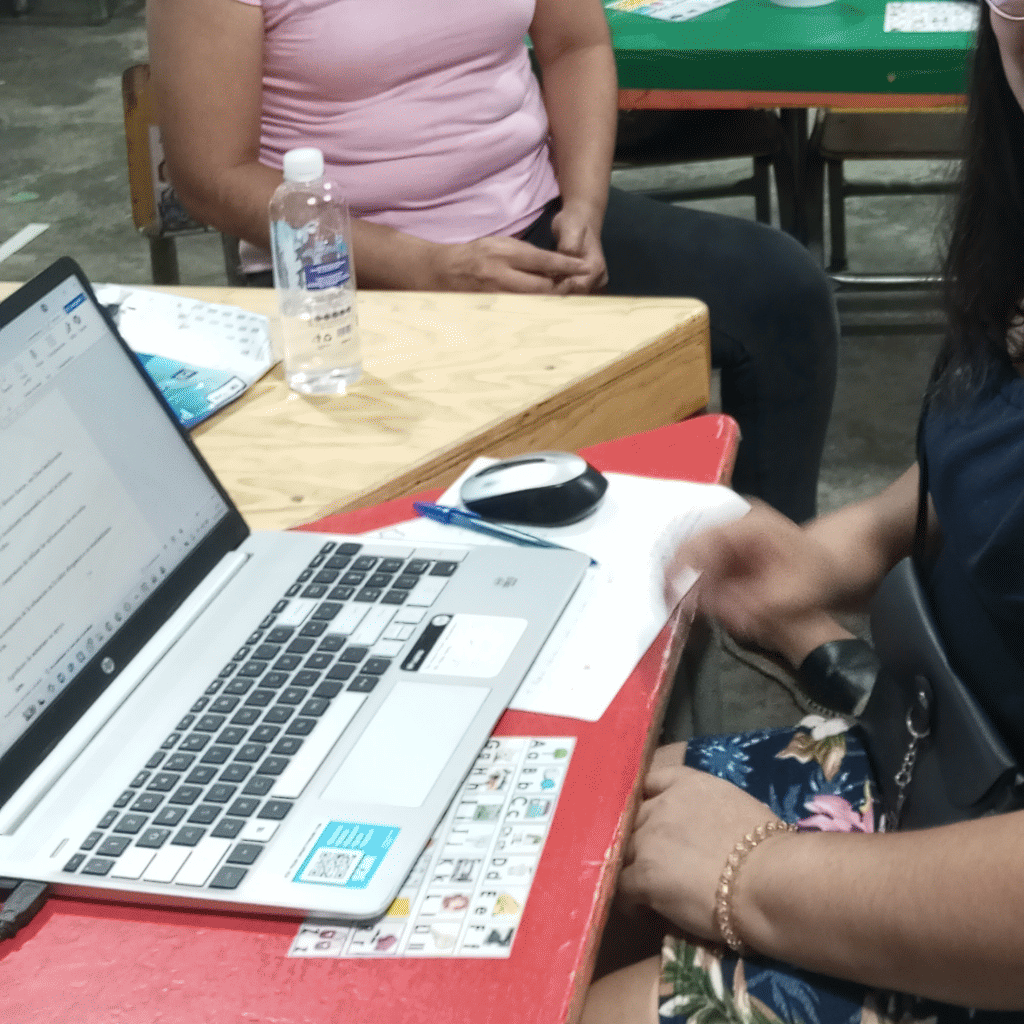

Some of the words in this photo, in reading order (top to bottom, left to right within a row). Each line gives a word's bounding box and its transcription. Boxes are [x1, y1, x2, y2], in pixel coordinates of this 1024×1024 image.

[510, 796, 527, 809] C
[492, 858, 507, 866] D
[475, 906, 487, 915] e
